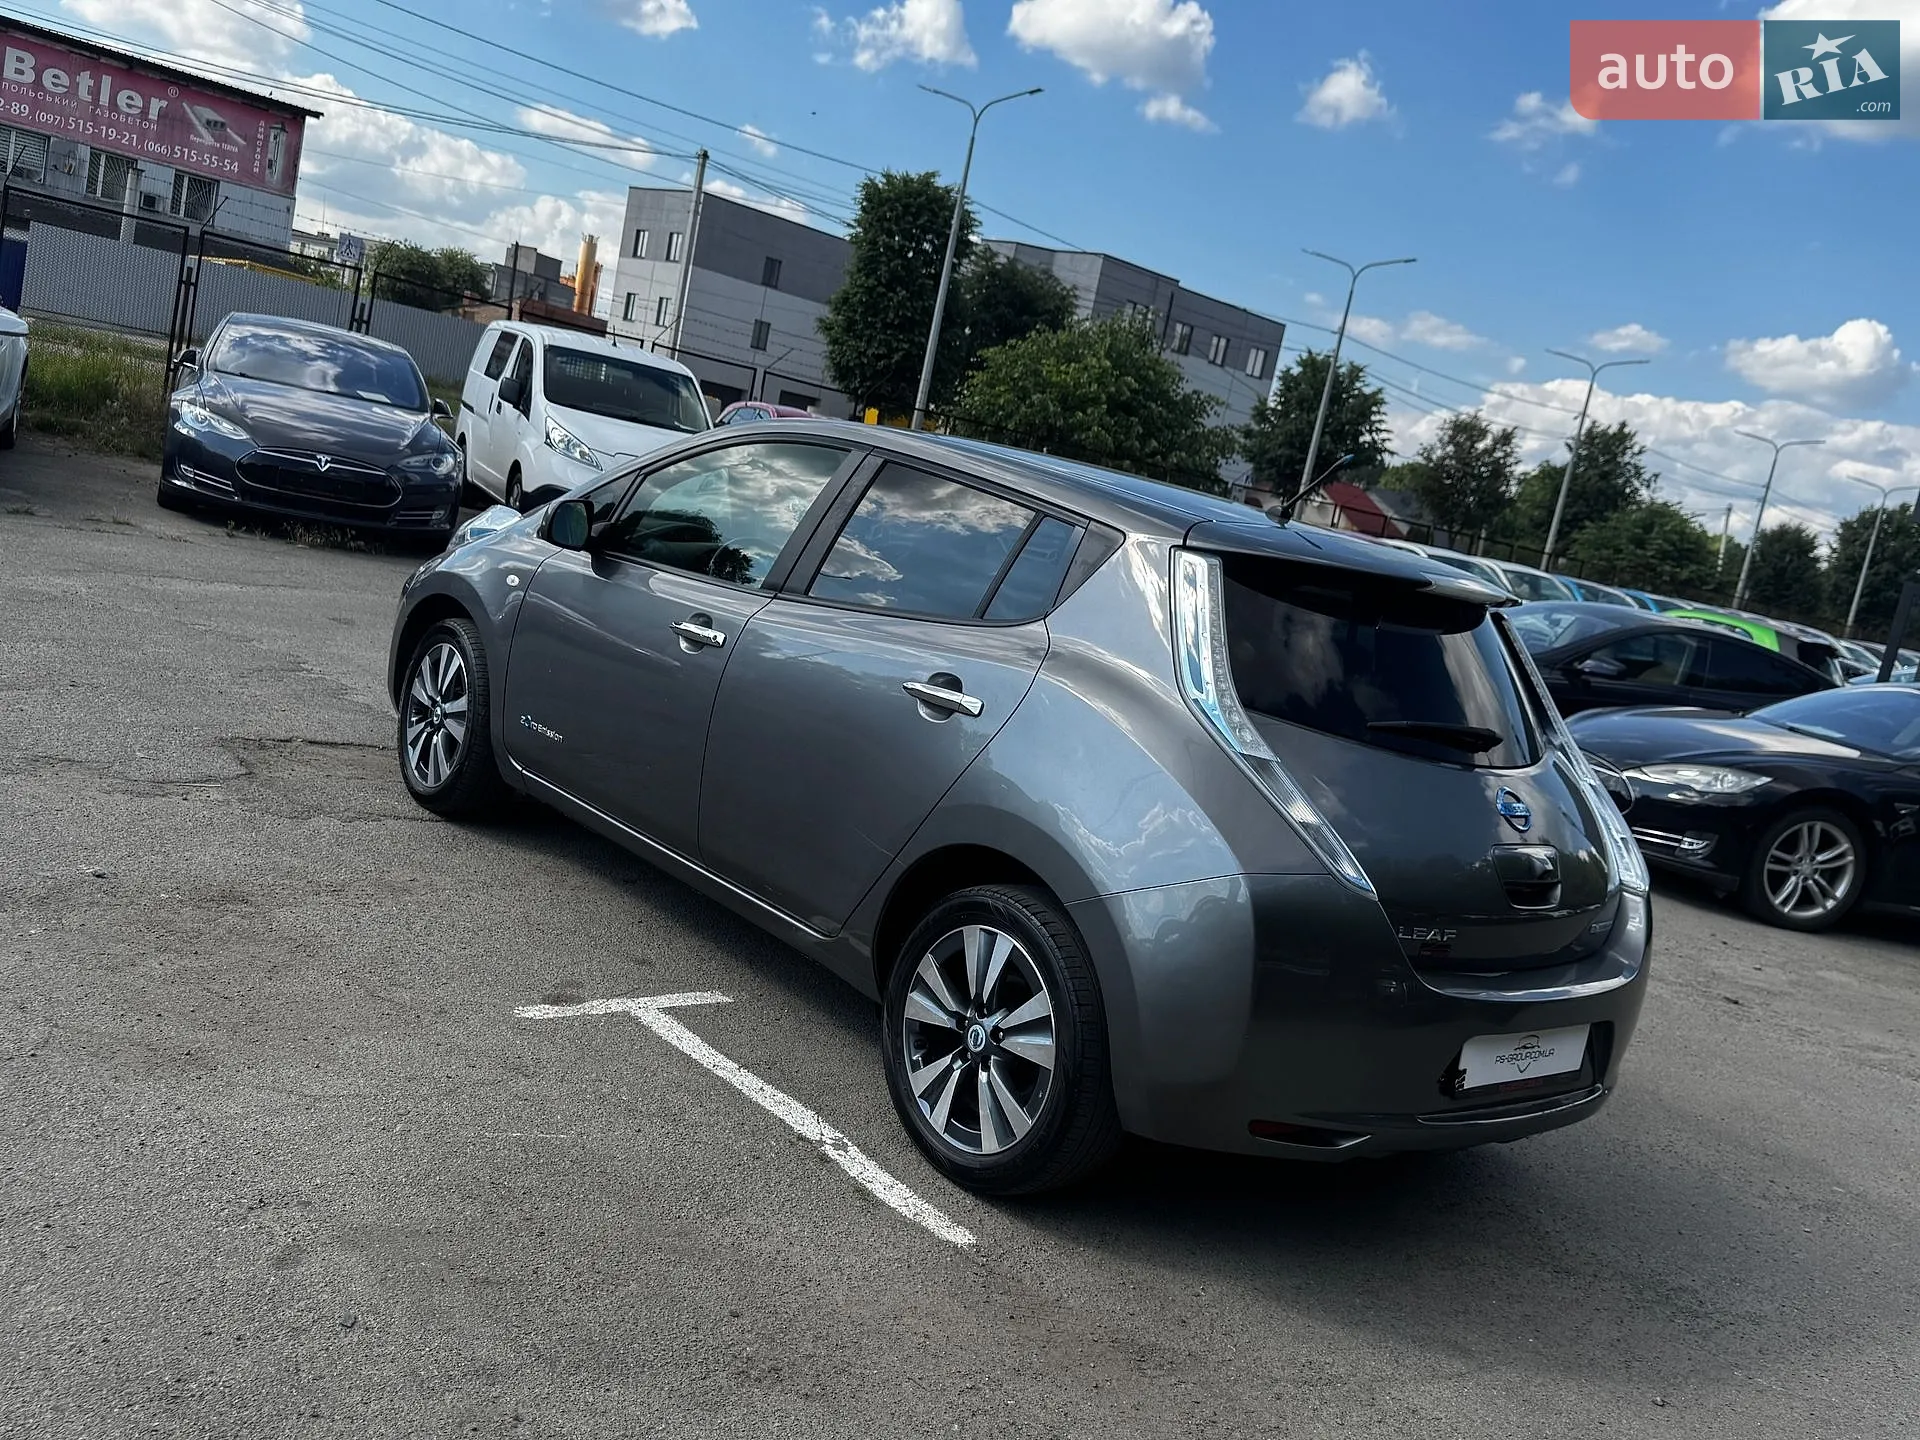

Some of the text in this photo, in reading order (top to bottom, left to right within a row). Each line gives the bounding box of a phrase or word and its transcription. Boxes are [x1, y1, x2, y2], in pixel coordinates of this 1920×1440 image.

[2, 46, 169, 121] Betler
[89, 105, 158, 131] ГАЗОБЕТОН
[35, 110, 65, 129] (097)
[67, 117, 142, 149] 515-19-21,
[144, 140, 172, 158] (066)
[173, 145, 239, 173] 515-55-54
[1398, 926, 1457, 941] LEAF
